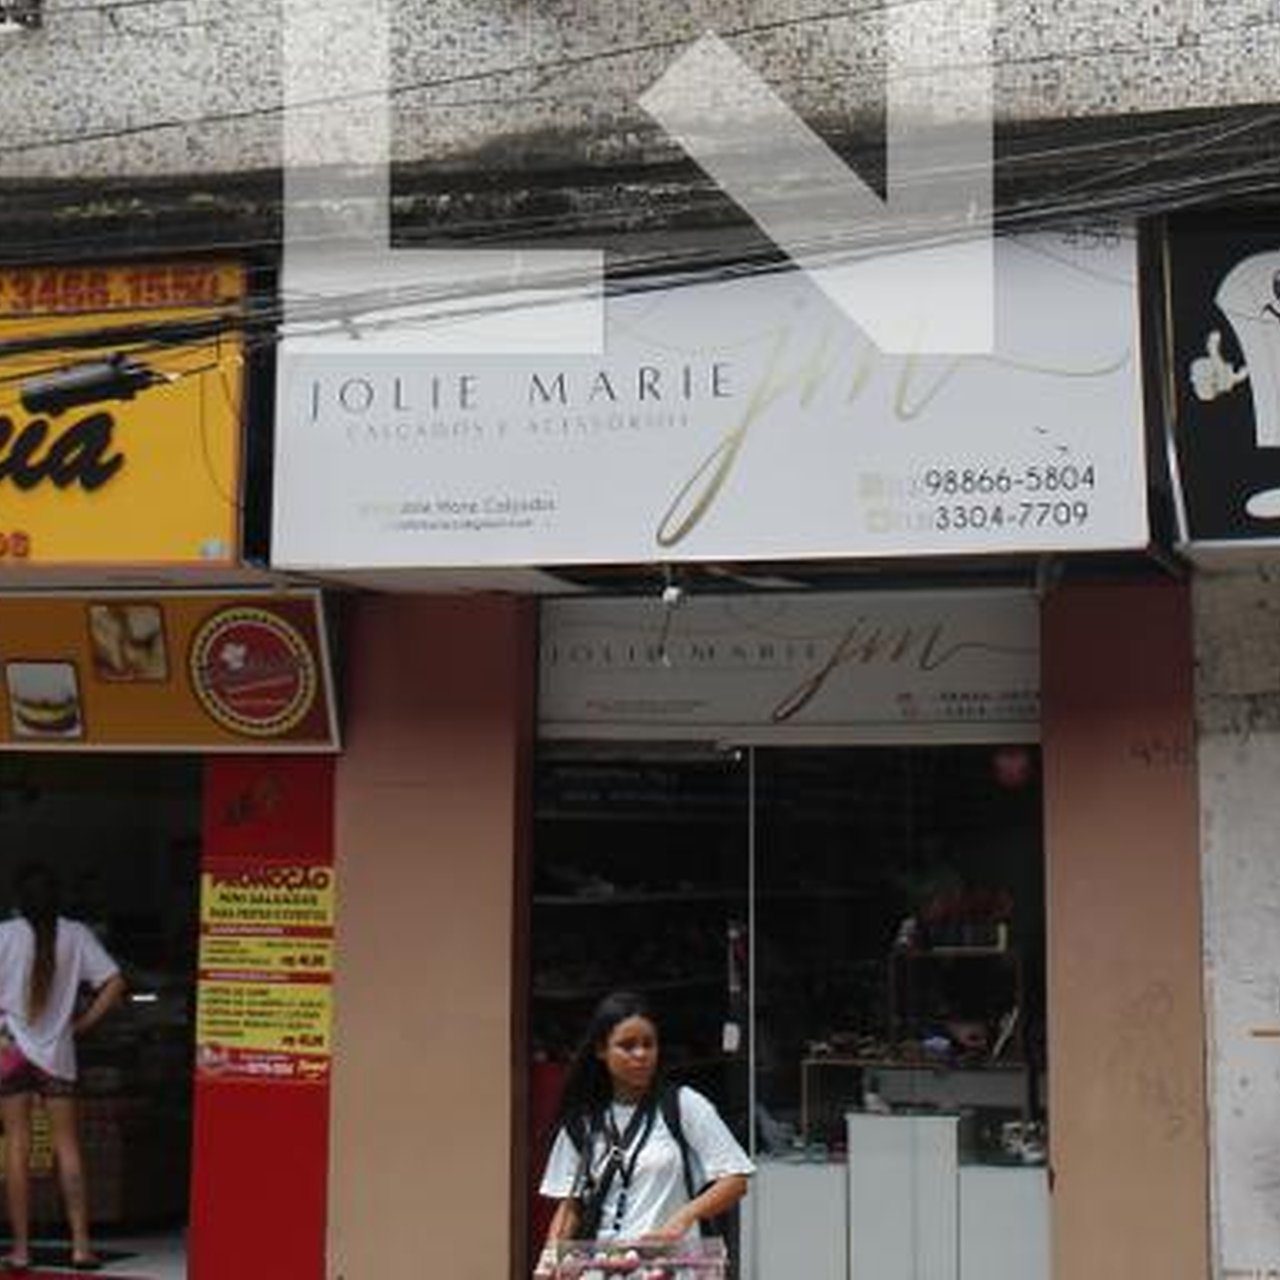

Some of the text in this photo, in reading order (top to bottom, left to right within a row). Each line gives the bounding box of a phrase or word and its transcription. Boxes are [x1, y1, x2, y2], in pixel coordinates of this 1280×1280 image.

[310, 361, 736, 421] JOLIE MARIE
[924, 464, 1096, 495] 98866-5804
[934, 501, 1089, 531] 3304-7709
